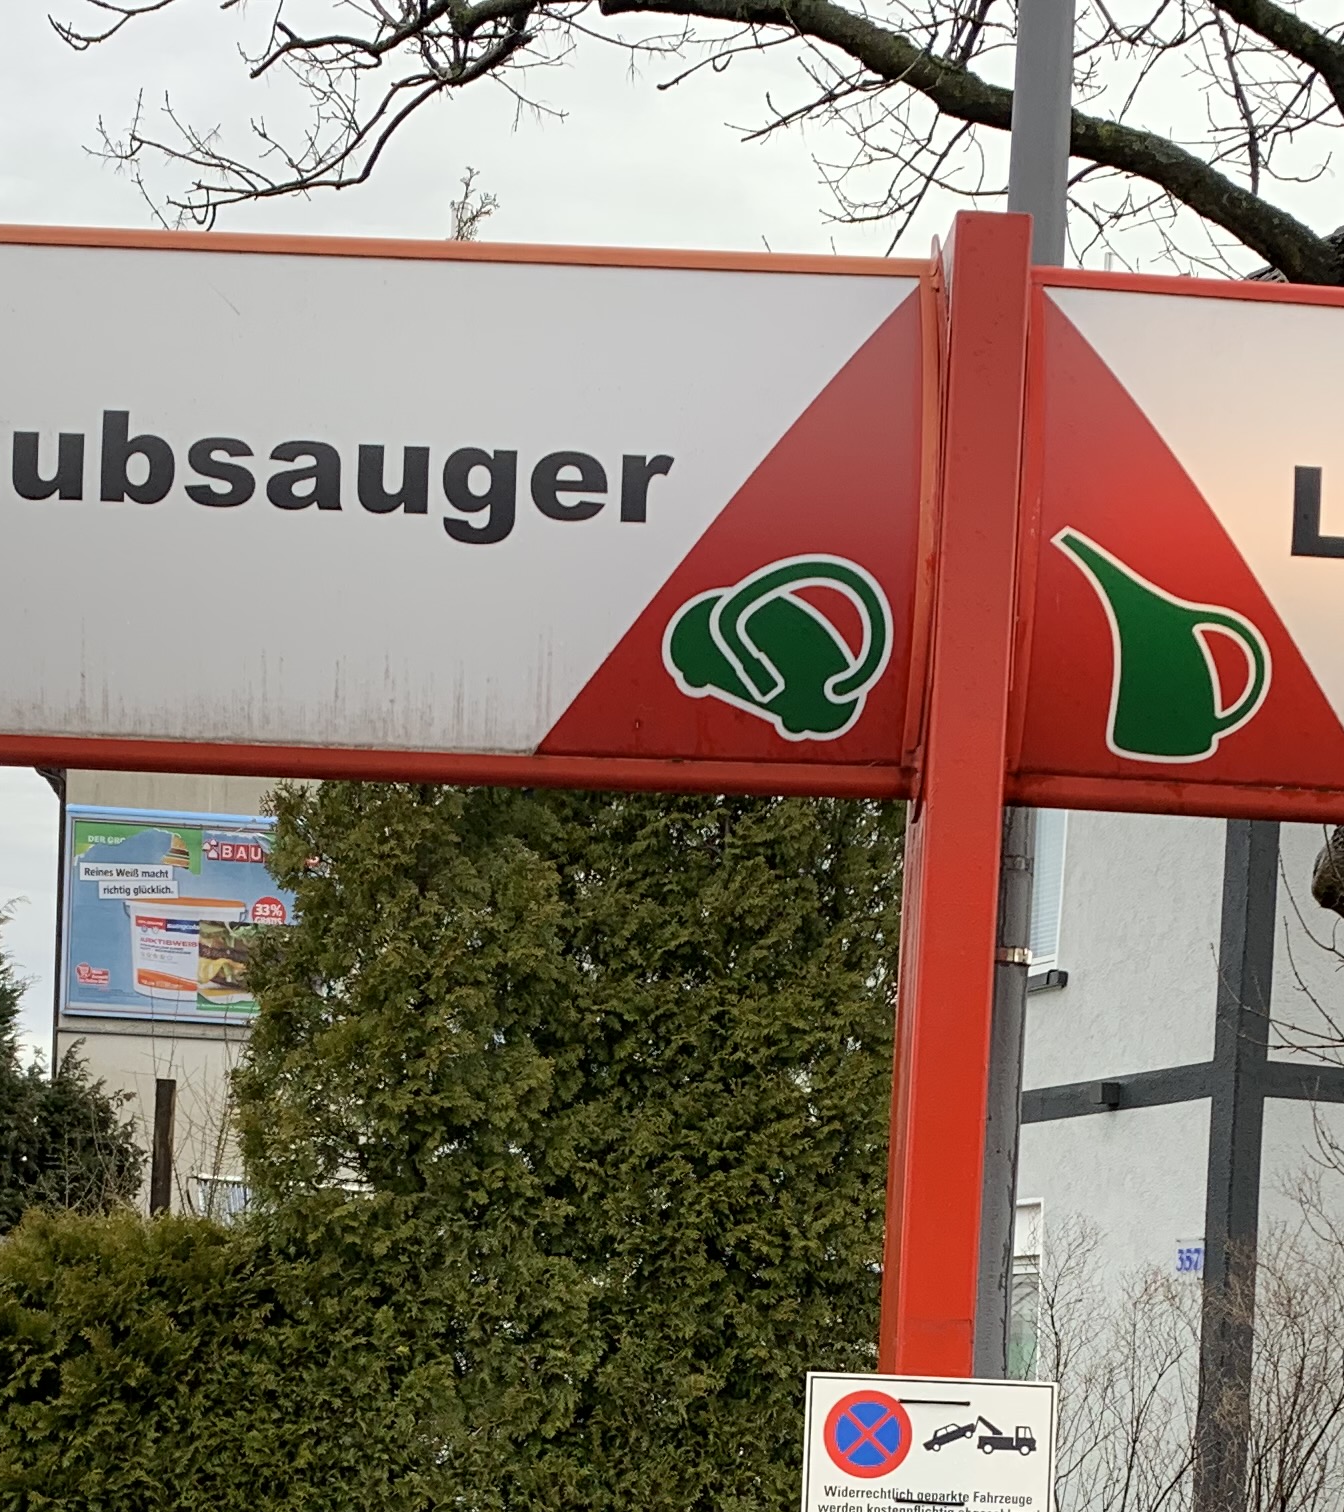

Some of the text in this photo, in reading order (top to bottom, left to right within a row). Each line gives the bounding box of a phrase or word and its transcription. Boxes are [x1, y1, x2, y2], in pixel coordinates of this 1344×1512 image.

[88, 835, 106, 844] DER
[84, 867, 169, 878] Reines Weiß macht
[103, 884, 174, 896] richtig glücklich.
[254, 903, 283, 917] 33%
[1176, 1247, 1202, 1271] 357
[824, 1485, 1033, 1507] Widerrechtlich geparkte Fahrzeuge
